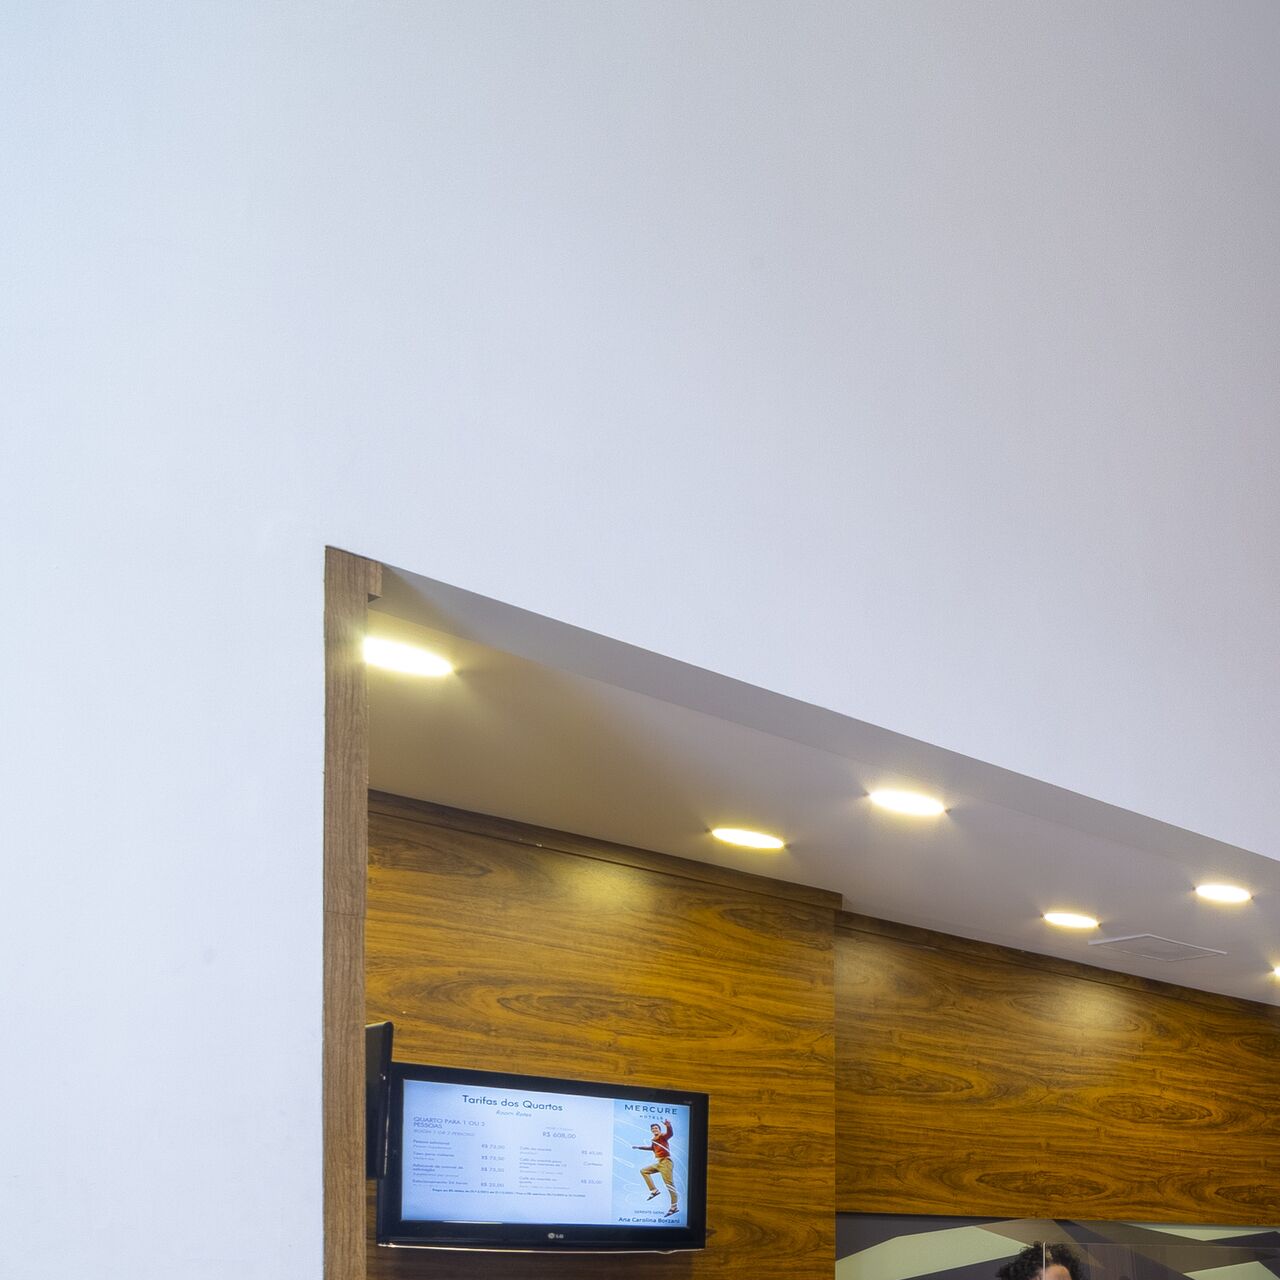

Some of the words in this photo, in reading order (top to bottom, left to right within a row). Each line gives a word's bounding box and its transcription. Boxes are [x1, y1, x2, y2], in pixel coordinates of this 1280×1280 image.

[462, 1094, 497, 1106] Tarifas
[501, 1099, 519, 1108] dos
[522, 1100, 563, 1111] Quartos
[624, 1104, 678, 1115] MERCURE
